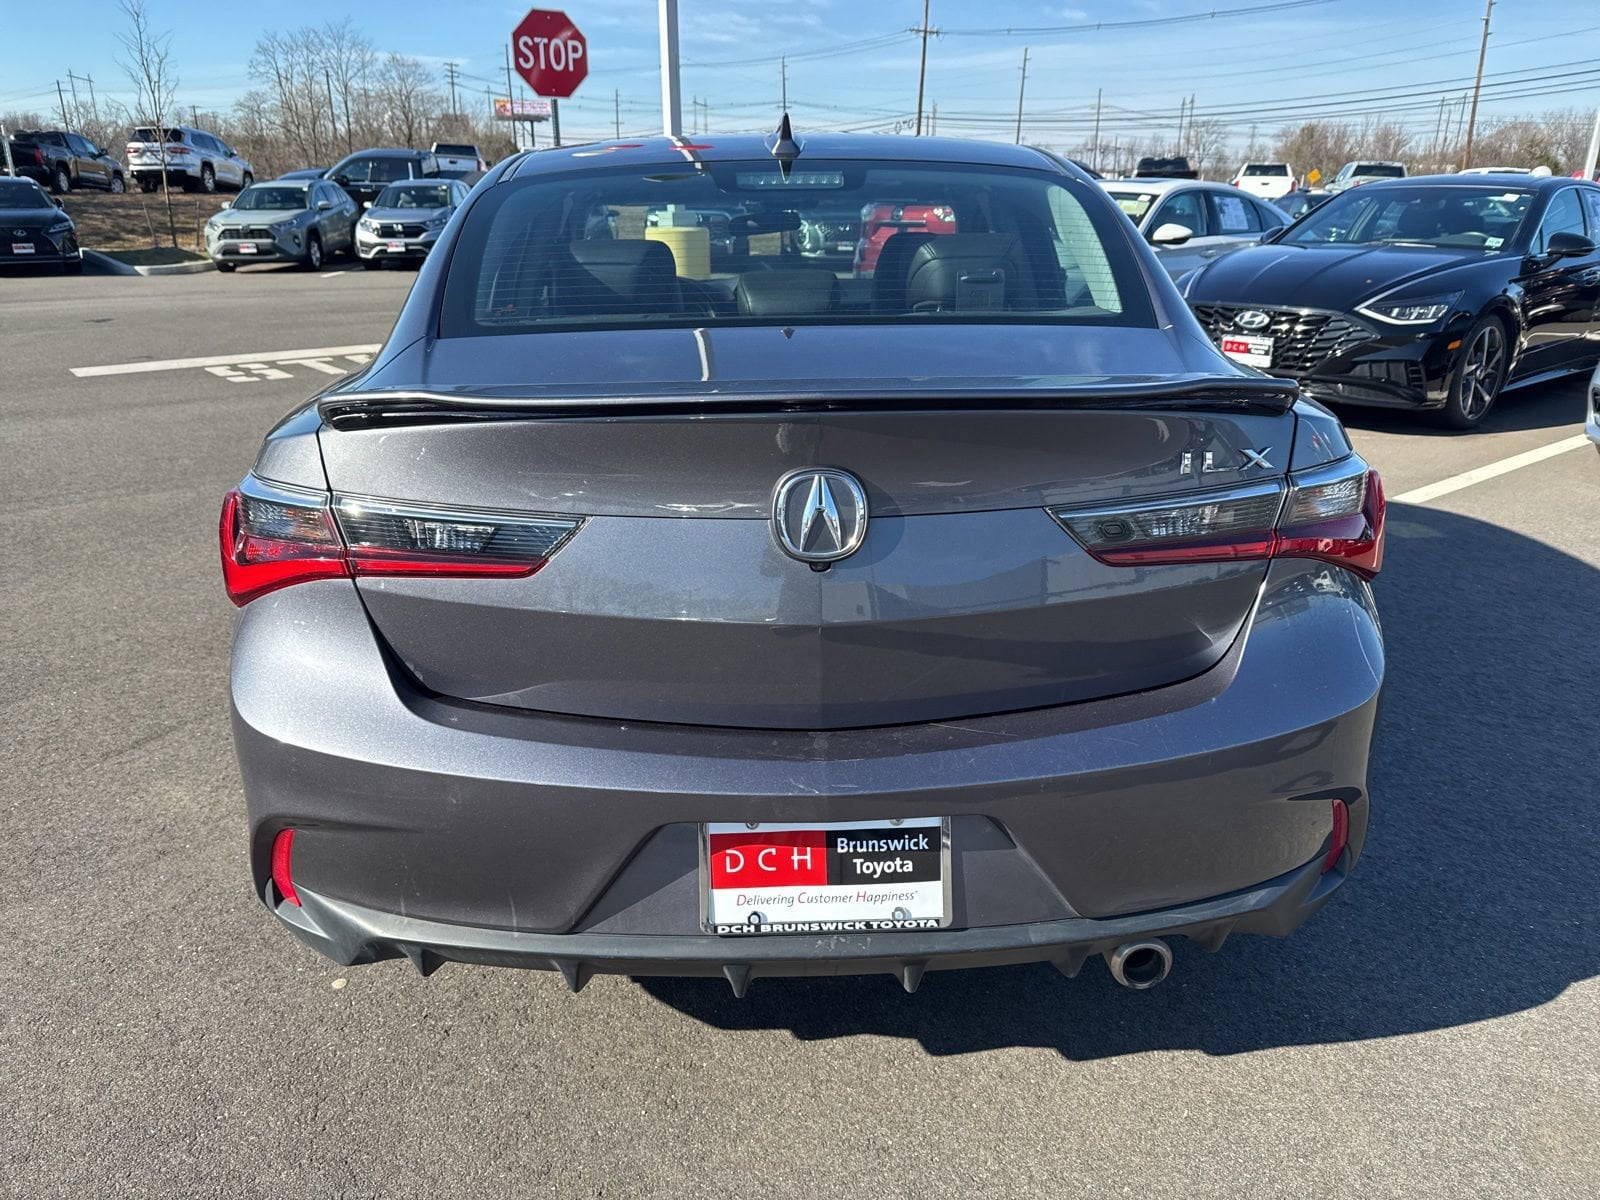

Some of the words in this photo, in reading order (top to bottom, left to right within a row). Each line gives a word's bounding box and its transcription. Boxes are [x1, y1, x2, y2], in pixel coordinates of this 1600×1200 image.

[518, 35, 583, 72] STOP
[1180, 446, 1276, 475] ILX
[836, 834, 929, 853] Brunswick
[852, 857, 914, 879] Toyota
[736, 894, 795, 907] Delivering
[797, 891, 853, 904] Customer
[716, 925, 756, 934] DCH
[760, 922, 867, 932] BRUNSWICK
[869, 919, 939, 930] TOYOTA
